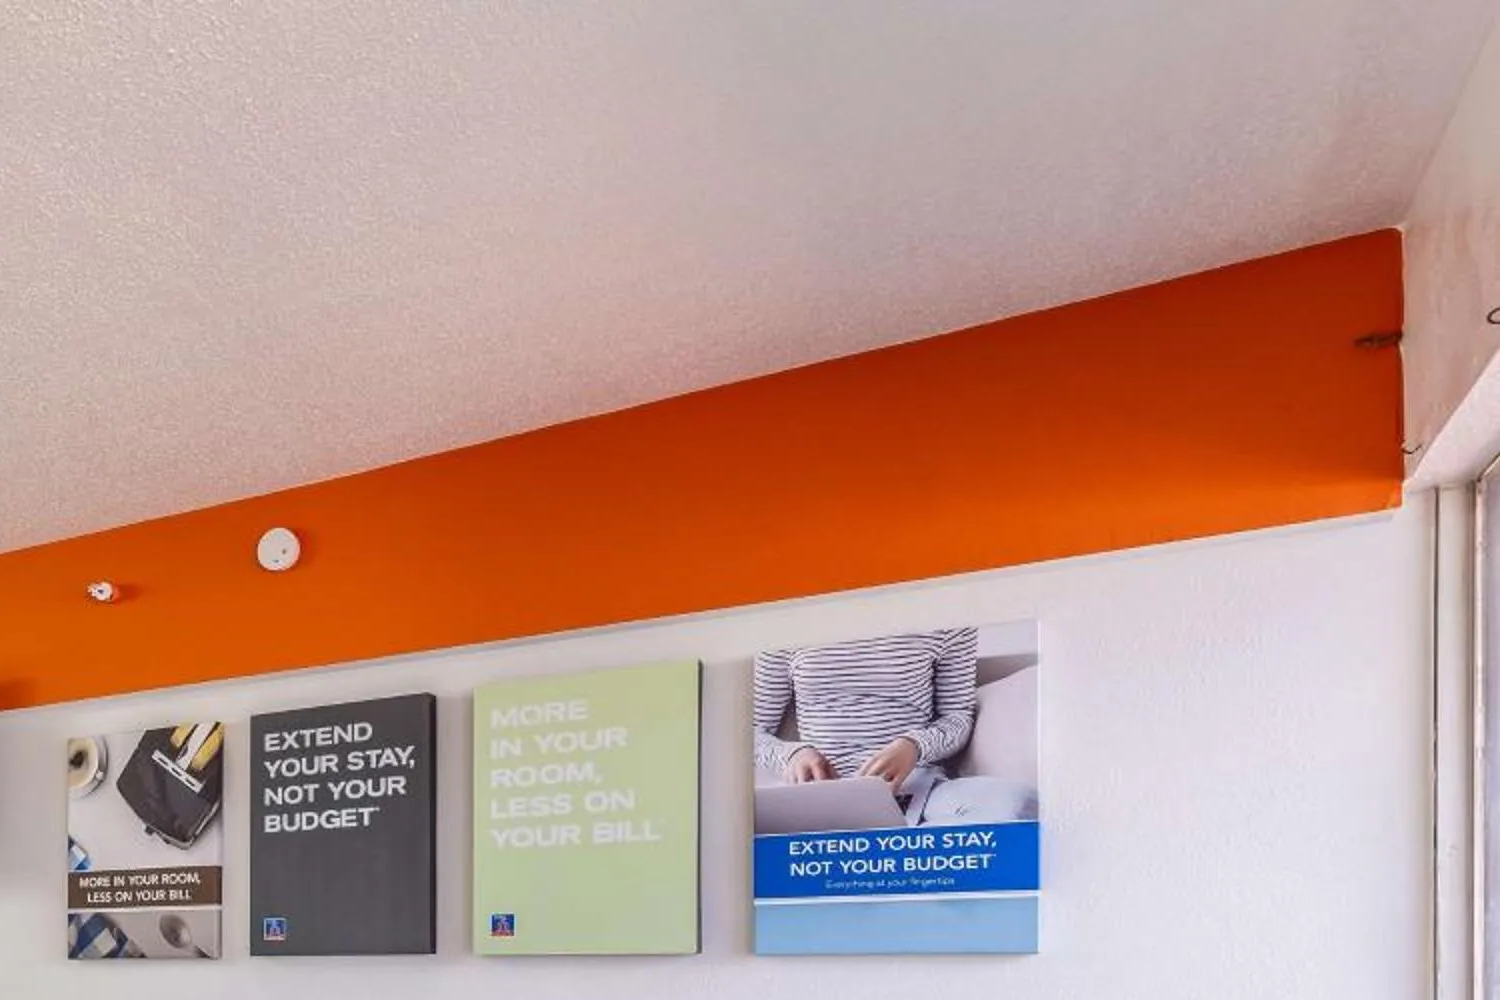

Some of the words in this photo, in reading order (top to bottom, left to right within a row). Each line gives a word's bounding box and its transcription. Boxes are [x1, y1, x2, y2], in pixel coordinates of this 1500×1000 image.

[490, 699, 589, 728] MORE
[264, 722, 373, 752] EXTEND
[490, 738, 522, 759] IN
[534, 726, 628, 754] YOUR
[264, 754, 339, 778] YOUR
[347, 745, 415, 771] STAY,
[490, 761, 603, 788] ROOM,
[264, 783, 320, 806] NOT
[327, 775, 407, 801] YOUR
[490, 793, 572, 819] LESS
[583, 789, 635, 813] ON
[264, 807, 373, 833] BUDGET
[489, 824, 581, 848] YOUR
[592, 820, 662, 843] BILL
[789, 837, 870, 856] EXTEND
[876, 834, 935, 851] YOUR
[942, 831, 997, 849] STAY,
[790, 861, 833, 877] NOT
[840, 857, 897, 875] YOUR
[903, 853, 989, 871] BUDGET
[79, 876, 111, 888] MORE
[113, 875, 126, 887] IN
[128, 874, 159, 885] YOUR
[161, 871, 200, 885] ROOM,
[87, 891, 112, 903] LESS
[115, 891, 133, 901] ON
[135, 889, 166, 901] YOUR
[169, 888, 192, 901] BILL
